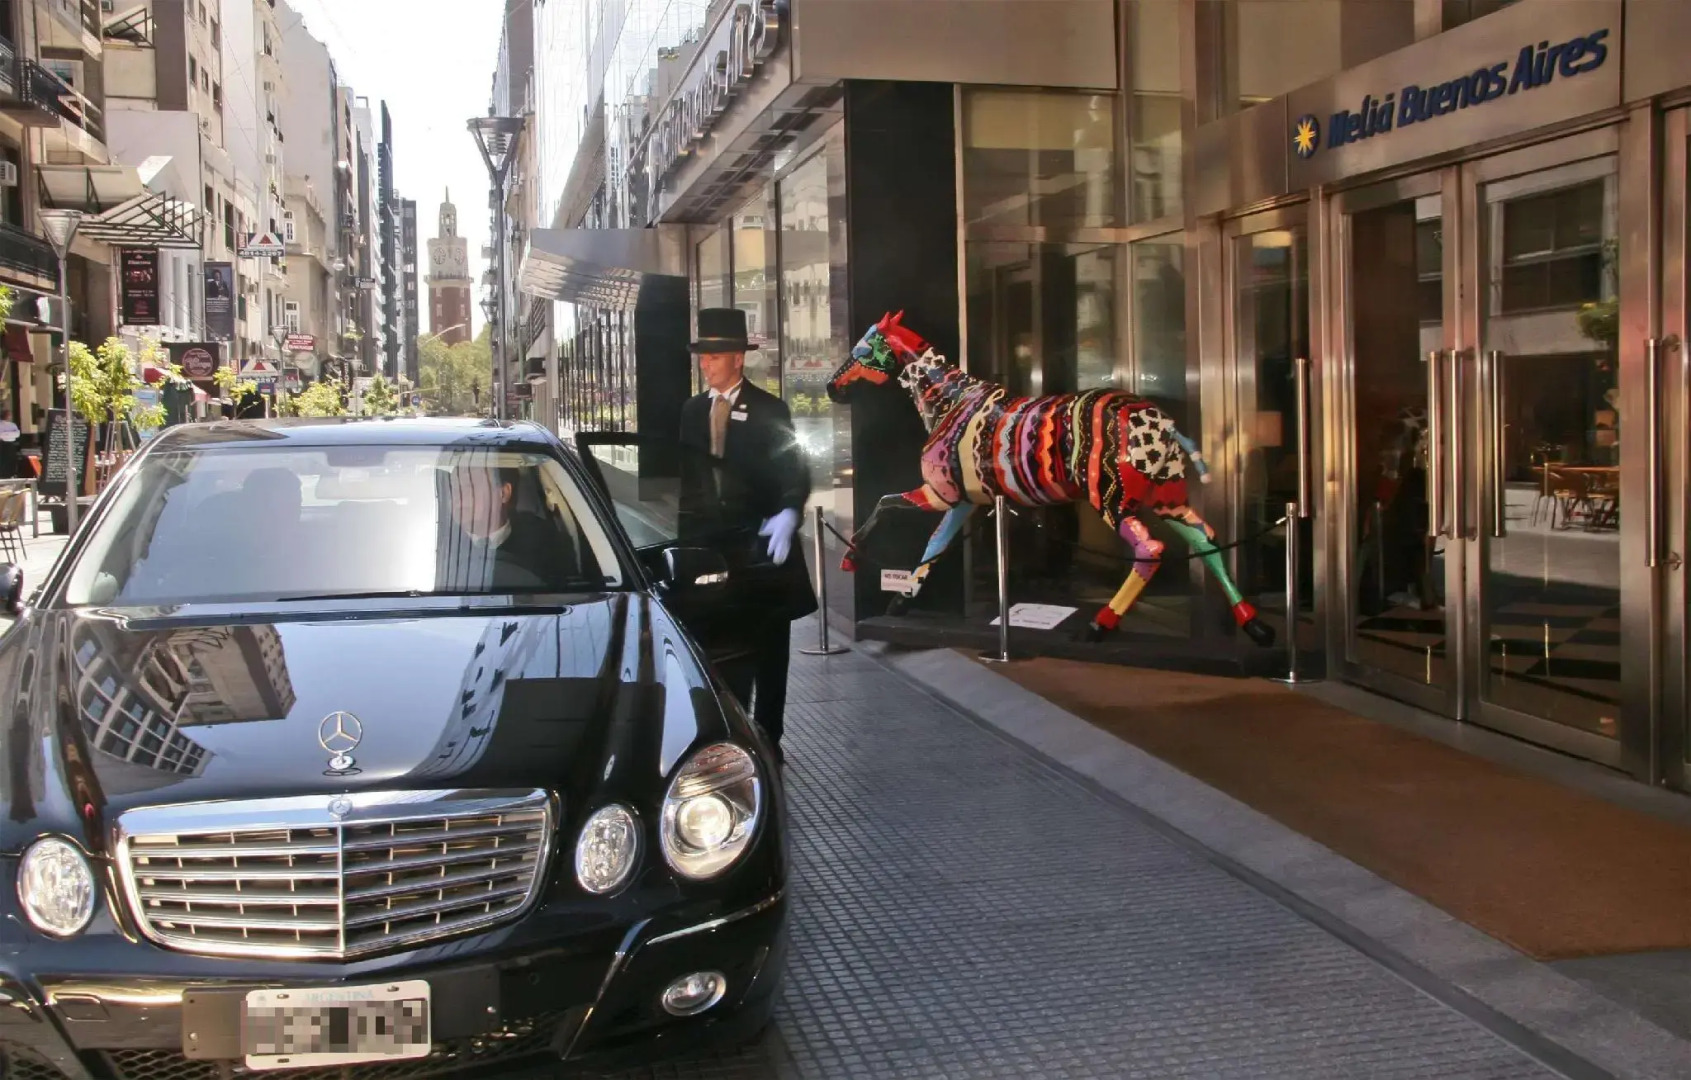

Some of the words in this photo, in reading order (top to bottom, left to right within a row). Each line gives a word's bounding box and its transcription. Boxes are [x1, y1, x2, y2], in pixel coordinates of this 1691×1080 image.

[1327, 93, 1395, 149] Meliá
[1397, 61, 1508, 128] Buenos
[1508, 28, 1609, 95] Aires
